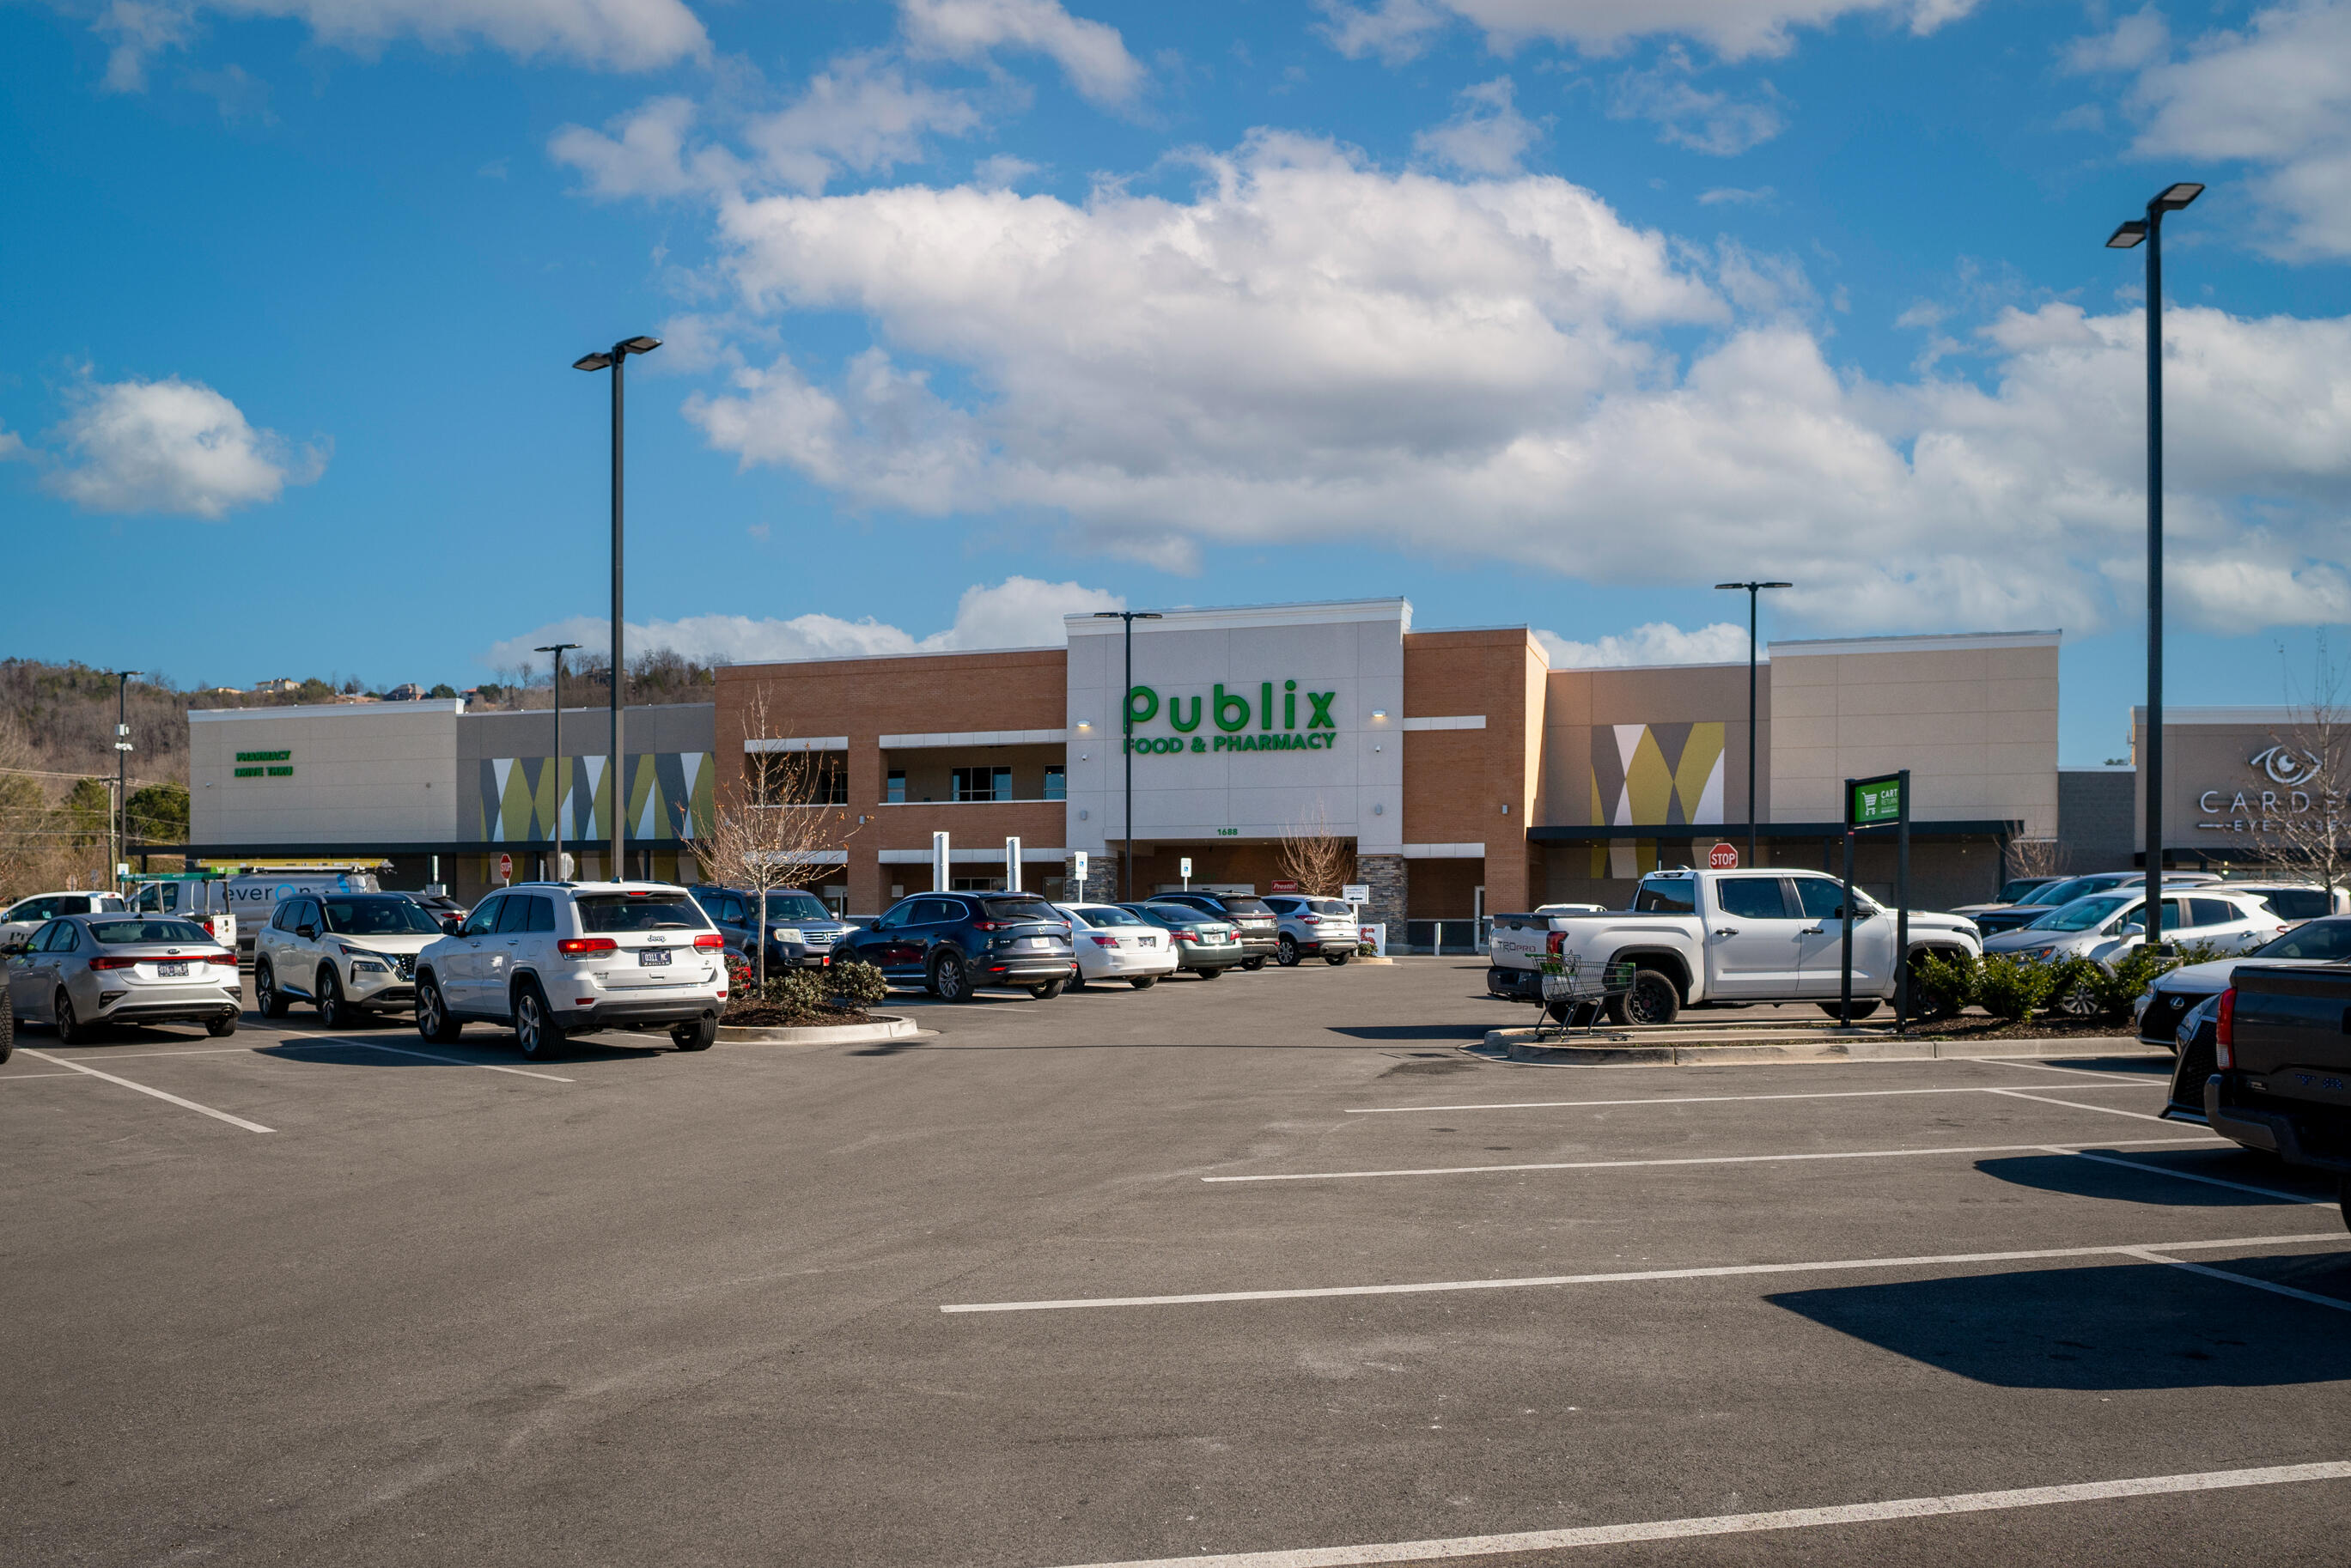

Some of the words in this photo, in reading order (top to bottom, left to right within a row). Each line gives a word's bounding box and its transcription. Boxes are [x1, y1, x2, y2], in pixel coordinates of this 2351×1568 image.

[1123, 679, 1336, 734] Publix
[1123, 738, 1184, 754] FOOD
[1191, 736, 1206, 753] &
[1213, 732, 1337, 752] PHARMACY
[236, 751, 291, 762] PHARMACY
[1880, 788, 1898, 799] CART
[2234, 820, 2271, 832] EYE
[1711, 853, 1736, 866] STOP
[1273, 882, 1297, 890] Presto!
